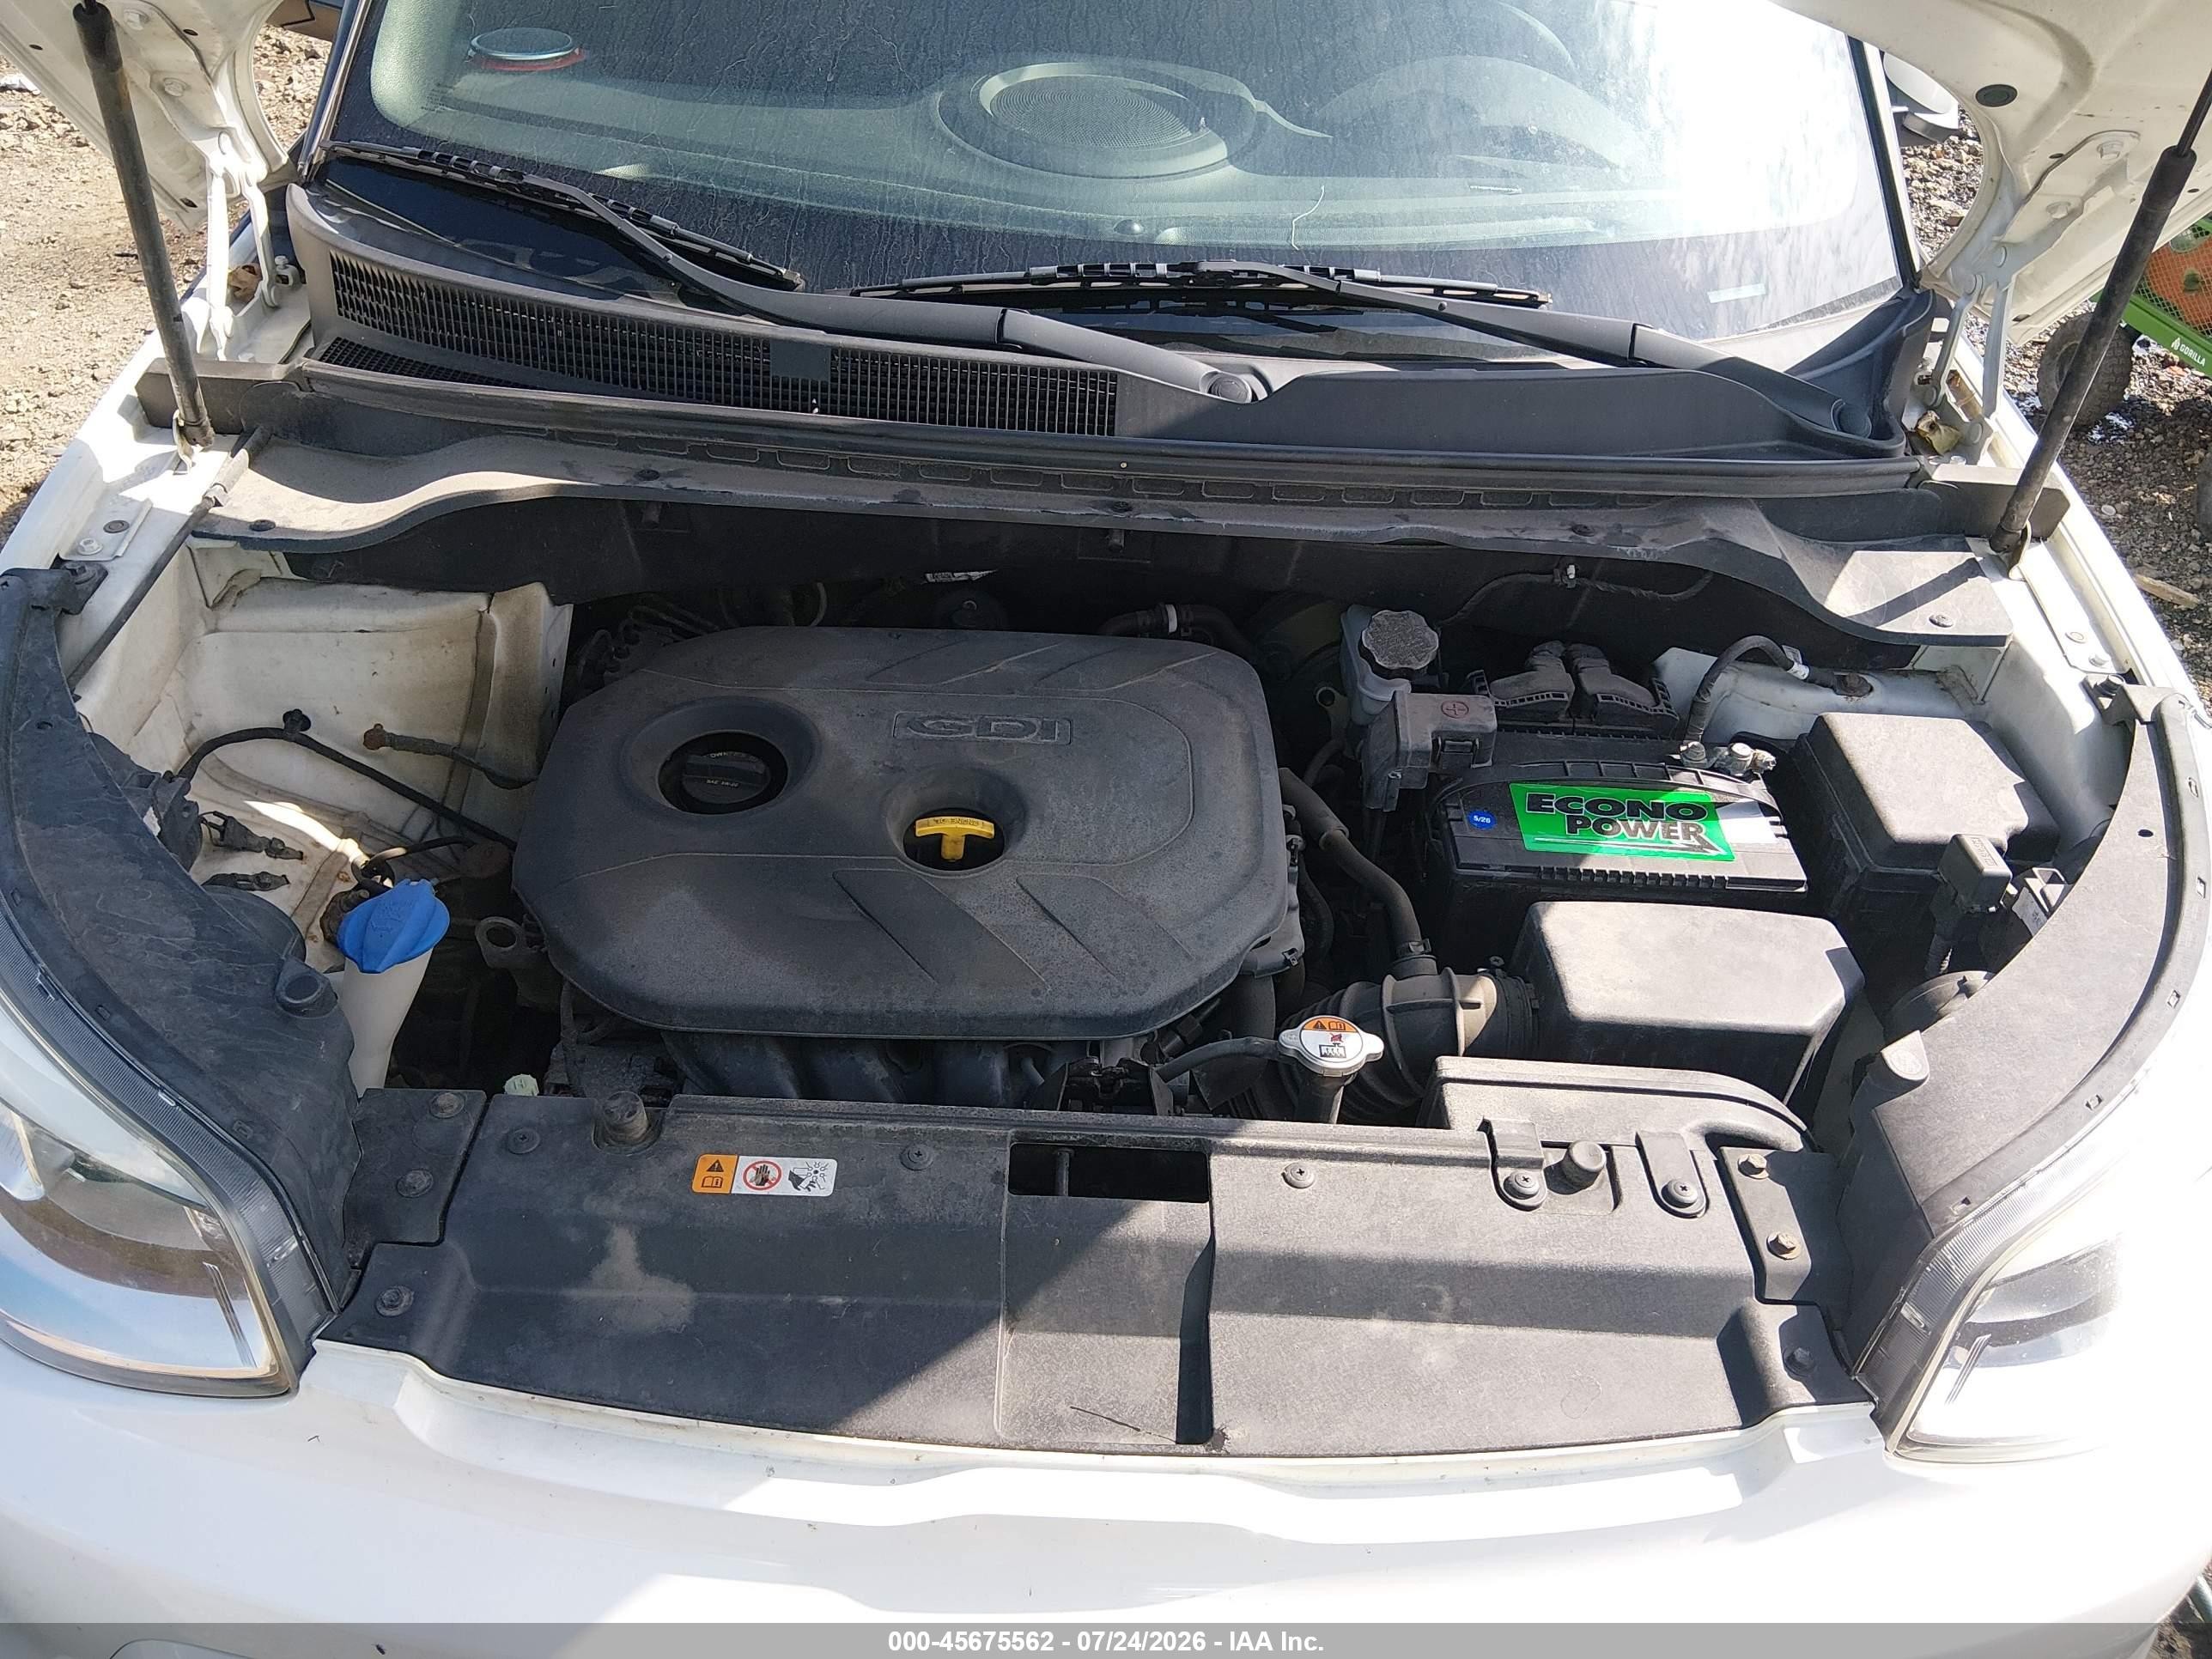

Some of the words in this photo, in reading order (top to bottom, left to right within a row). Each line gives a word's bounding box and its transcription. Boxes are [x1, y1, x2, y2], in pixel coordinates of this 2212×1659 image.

[2179, 343, 2206, 368] GORILLA
[907, 715, 1059, 742] GDI
[1525, 792, 1708, 822] ECONO
[1565, 814, 1709, 842] POWER
